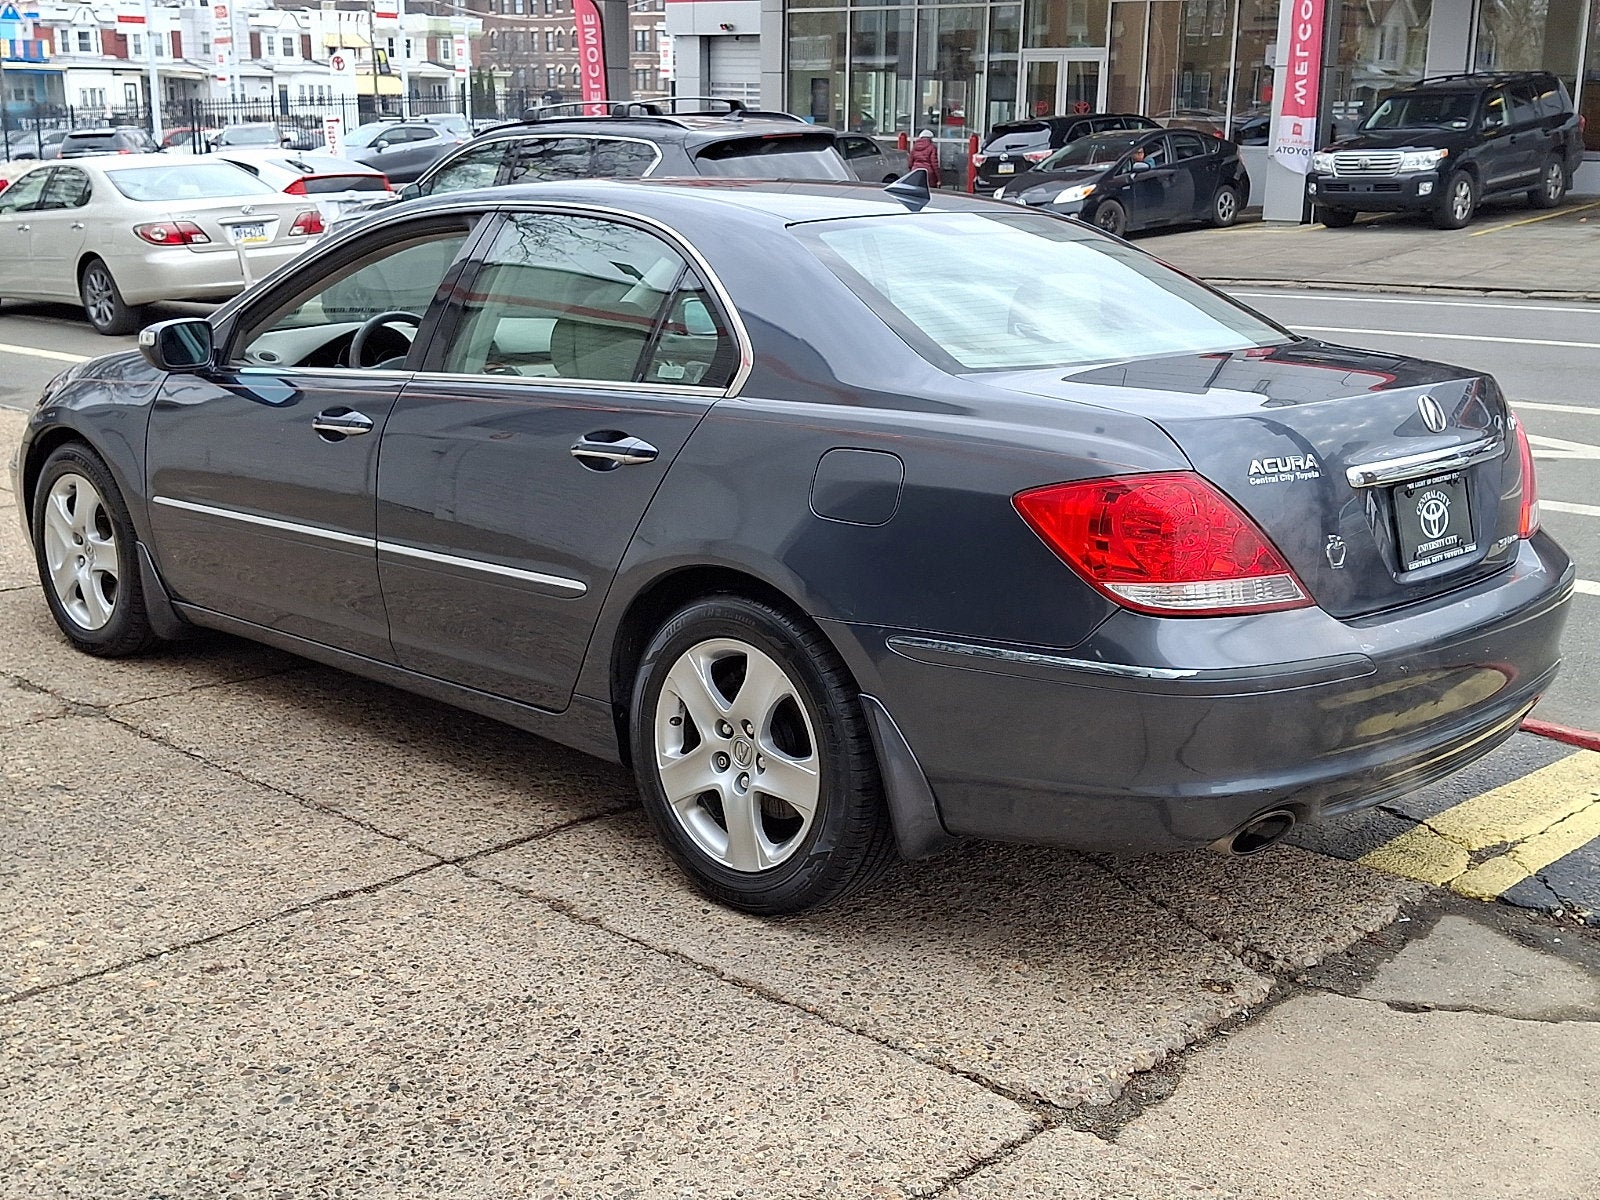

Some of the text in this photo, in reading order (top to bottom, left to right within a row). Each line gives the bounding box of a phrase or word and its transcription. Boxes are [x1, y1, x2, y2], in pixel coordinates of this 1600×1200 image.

[1248, 453, 1319, 476] ACURA
[1249, 470, 1320, 486] Central City Toyota
[1416, 490, 1452, 516] CENTRAL CITY
[1445, 535, 1458, 546] CITY
[1408, 557, 1431, 571] CENTRAL
[1431, 554, 1444, 564] CITY
